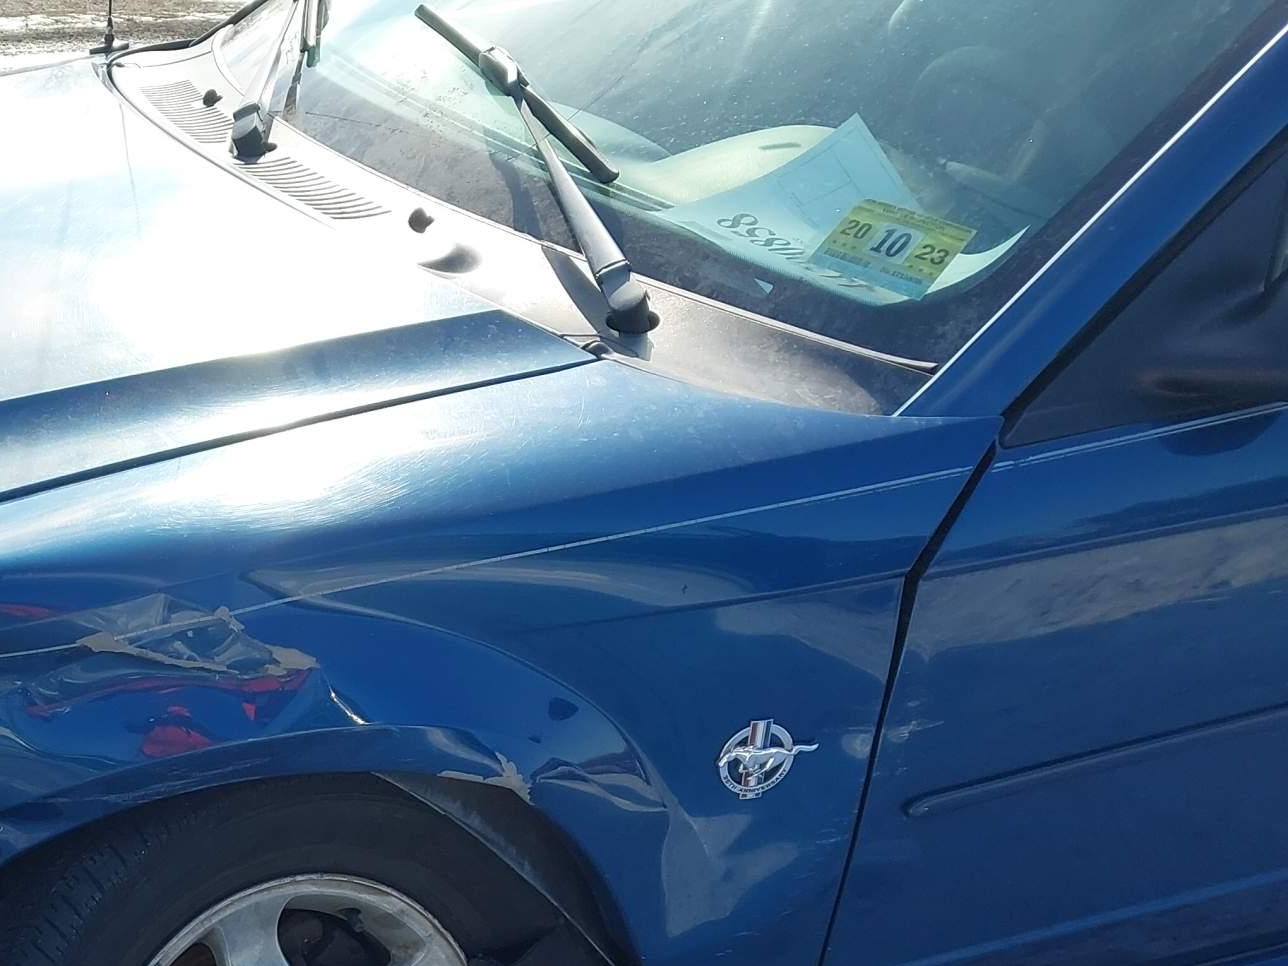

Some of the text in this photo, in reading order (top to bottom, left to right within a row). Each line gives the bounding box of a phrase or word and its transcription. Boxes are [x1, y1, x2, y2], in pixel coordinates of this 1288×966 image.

[840, 219, 873, 240] 20
[869, 228, 913, 258] 10
[914, 244, 950, 266] 23
